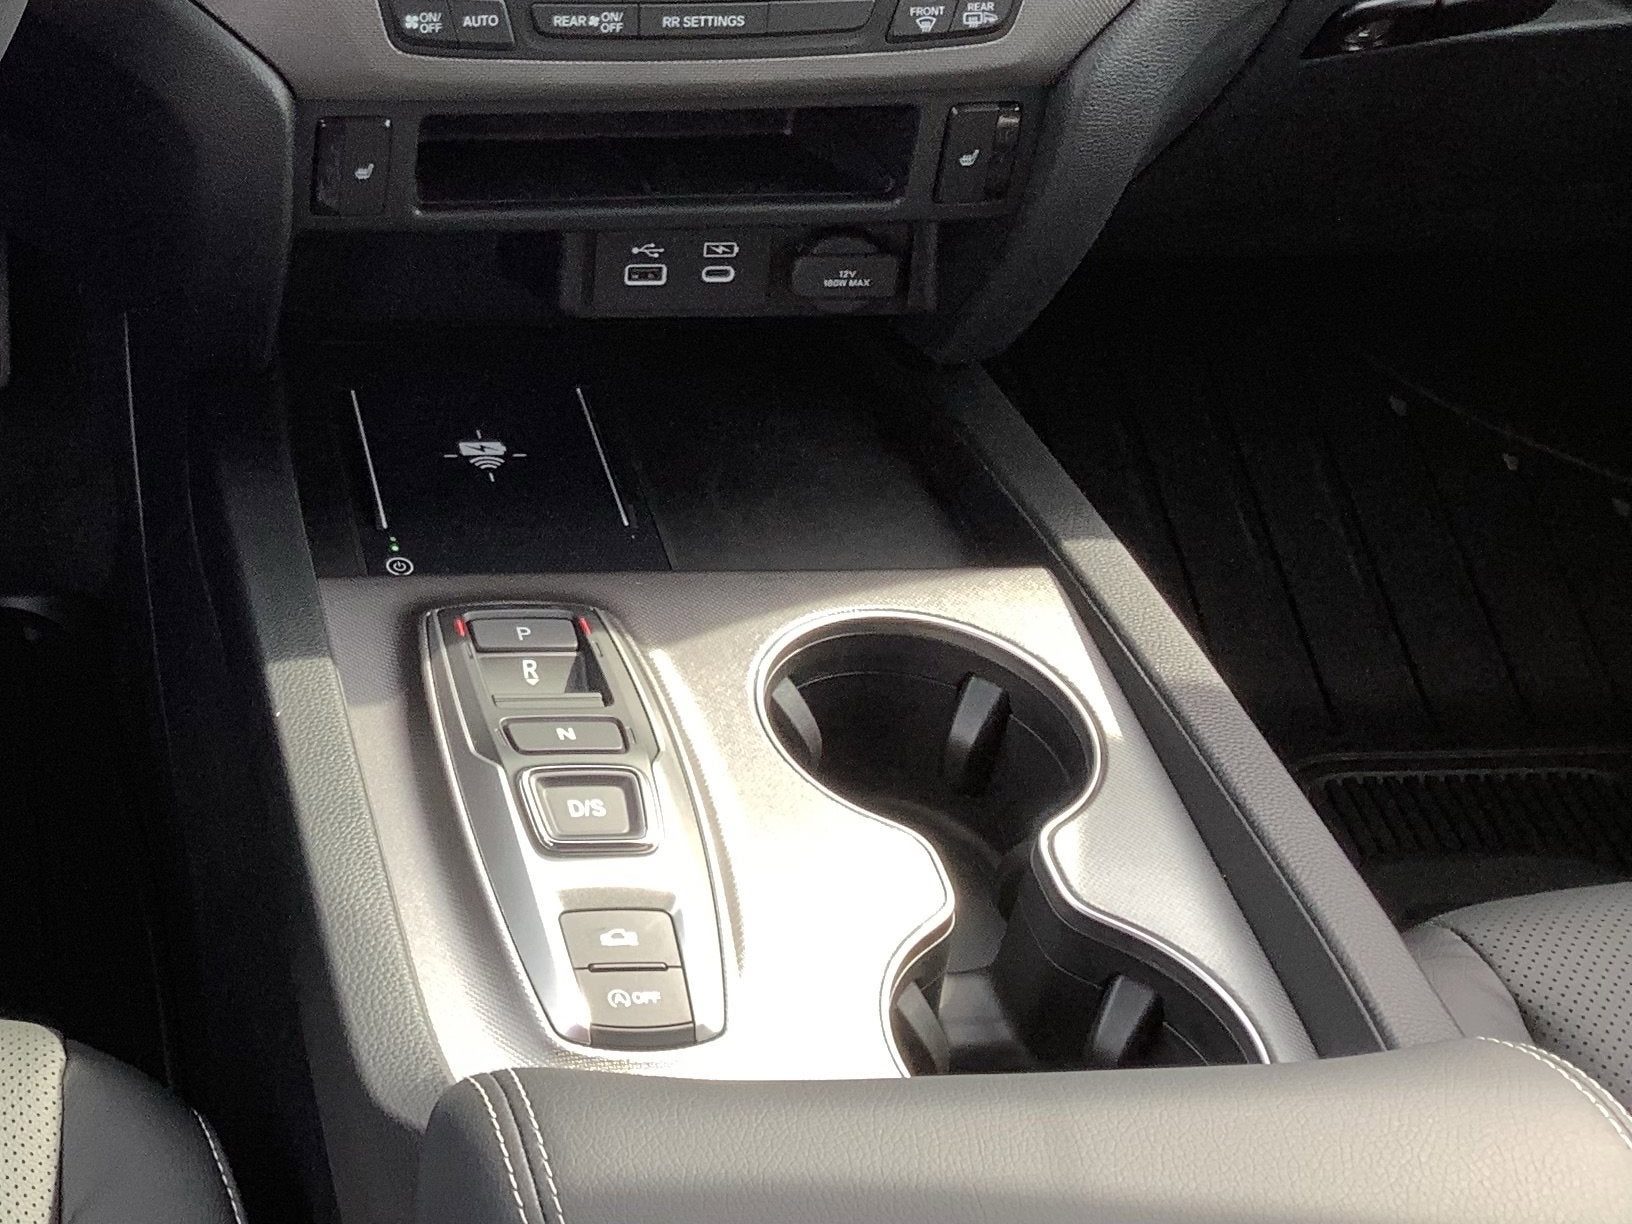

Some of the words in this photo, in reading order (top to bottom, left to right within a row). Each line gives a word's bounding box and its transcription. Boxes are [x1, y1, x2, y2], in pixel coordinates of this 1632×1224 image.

[910, 6, 945, 17] FRONT
[967, 2, 995, 12] REAR
[419, 13, 442, 24] ON/
[463, 15, 499, 27] AUTO
[553, 15, 586, 27] REAR
[601, 12, 624, 23] ON/
[662, 16, 680, 27] RR
[683, 15, 746, 27] SETTINGS
[419, 23, 442, 34] OFF
[600, 22, 624, 33] OFF
[839, 270, 856, 278] 12V
[848, 279, 870, 287] MAX
[516, 627, 531, 640] P
[522, 659, 537, 679] R
[556, 727, 576, 741] N
[567, 798, 607, 817] D/S
